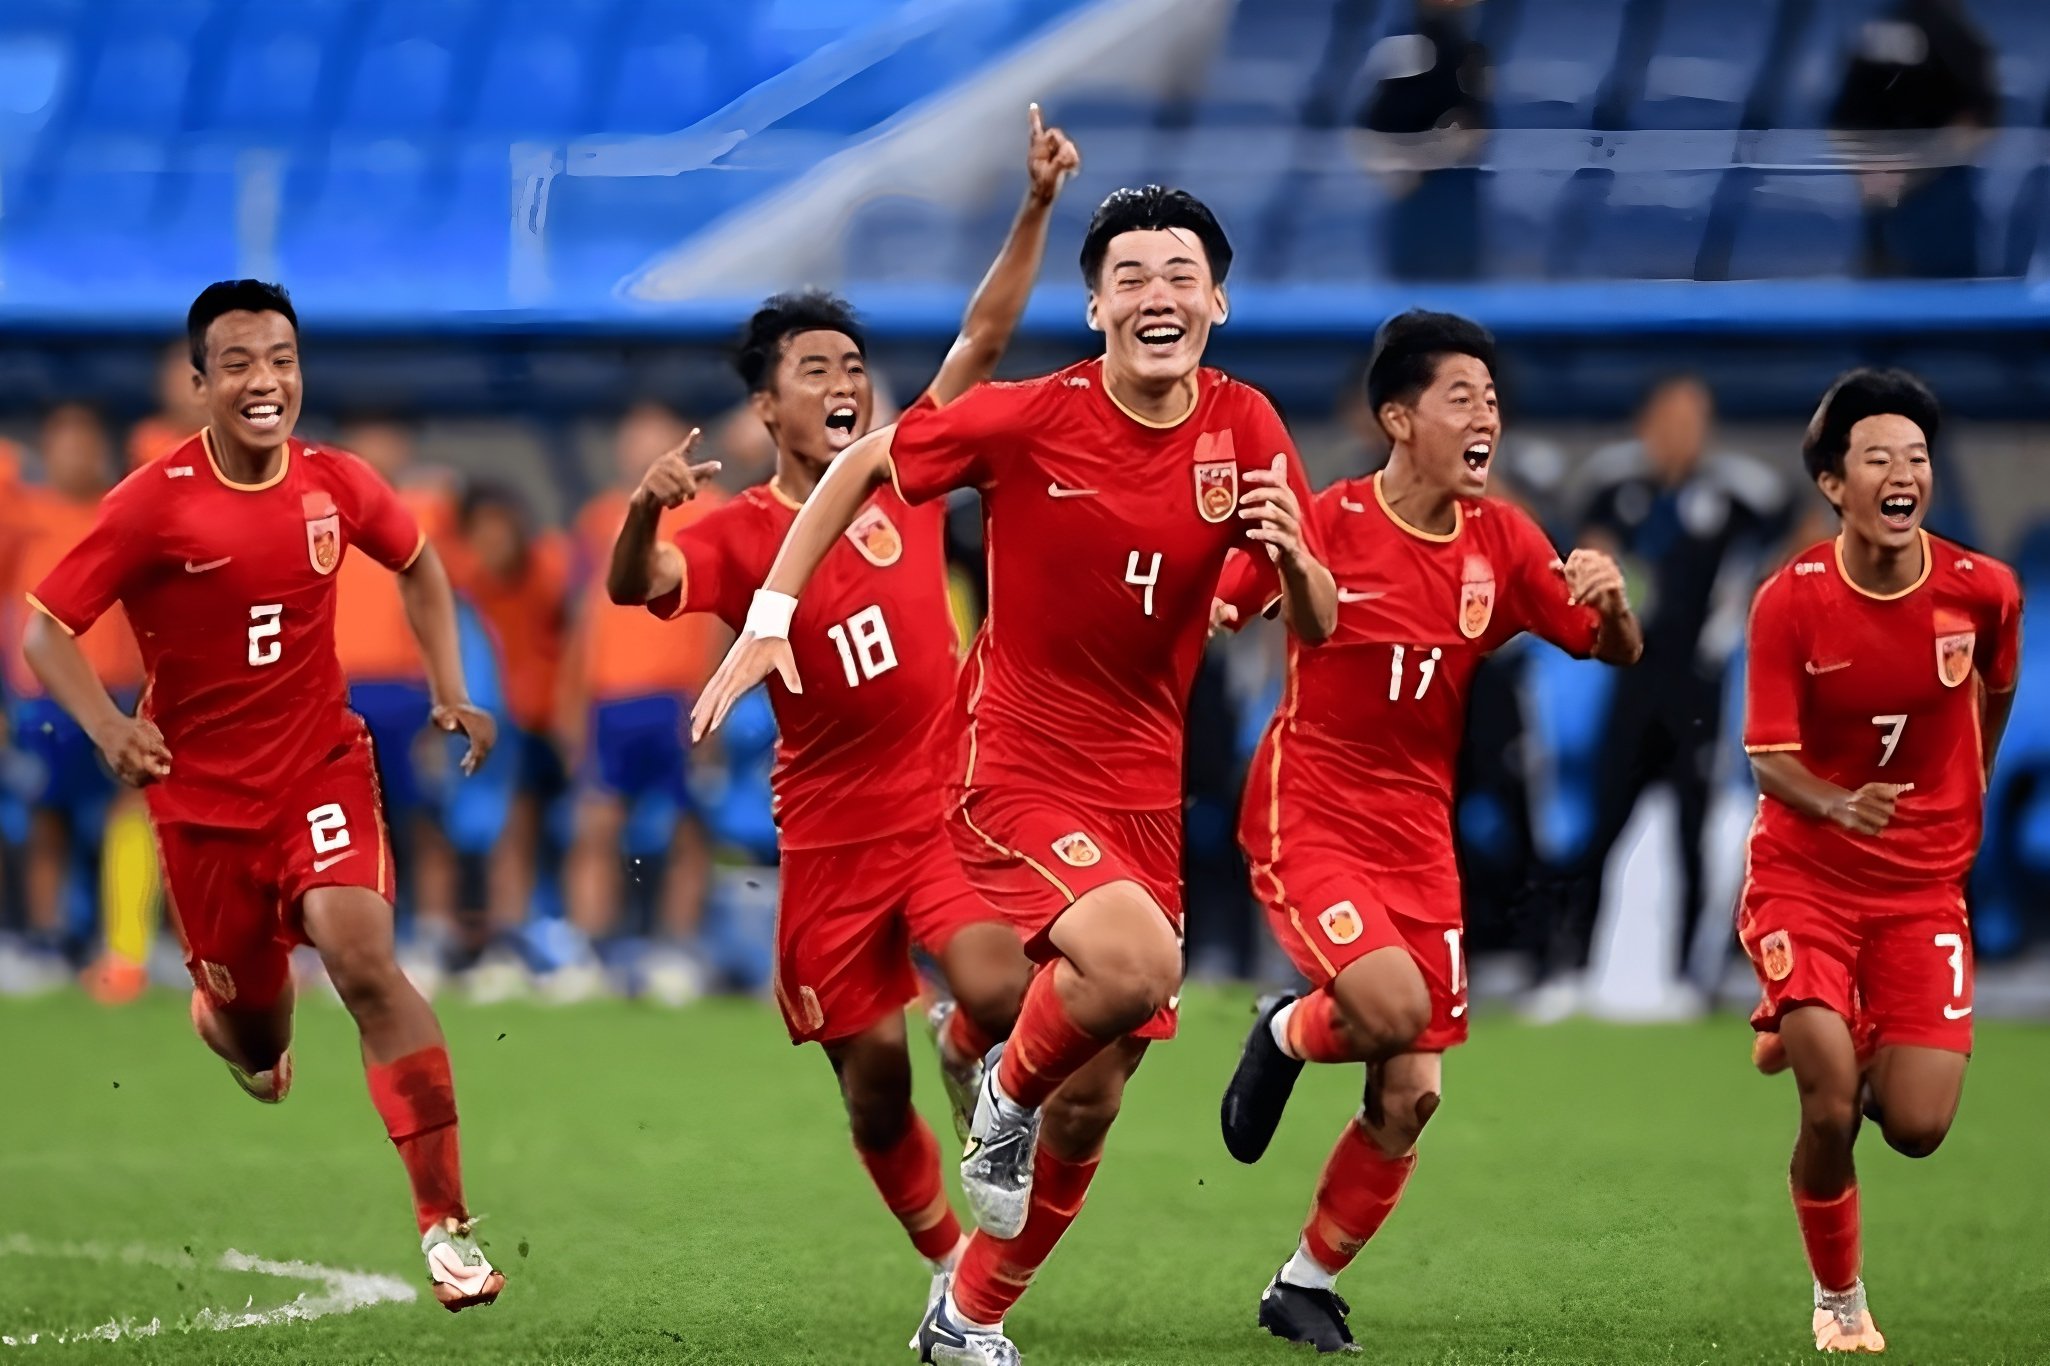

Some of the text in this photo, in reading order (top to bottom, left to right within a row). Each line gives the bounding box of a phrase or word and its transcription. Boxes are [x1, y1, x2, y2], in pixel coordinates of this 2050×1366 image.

[1124, 550, 1163, 616] 4
[248, 603, 283, 666] 2
[827, 604, 898, 688] 18
[1871, 714, 1909, 767] 7
[1934, 933, 1964, 998] 7
